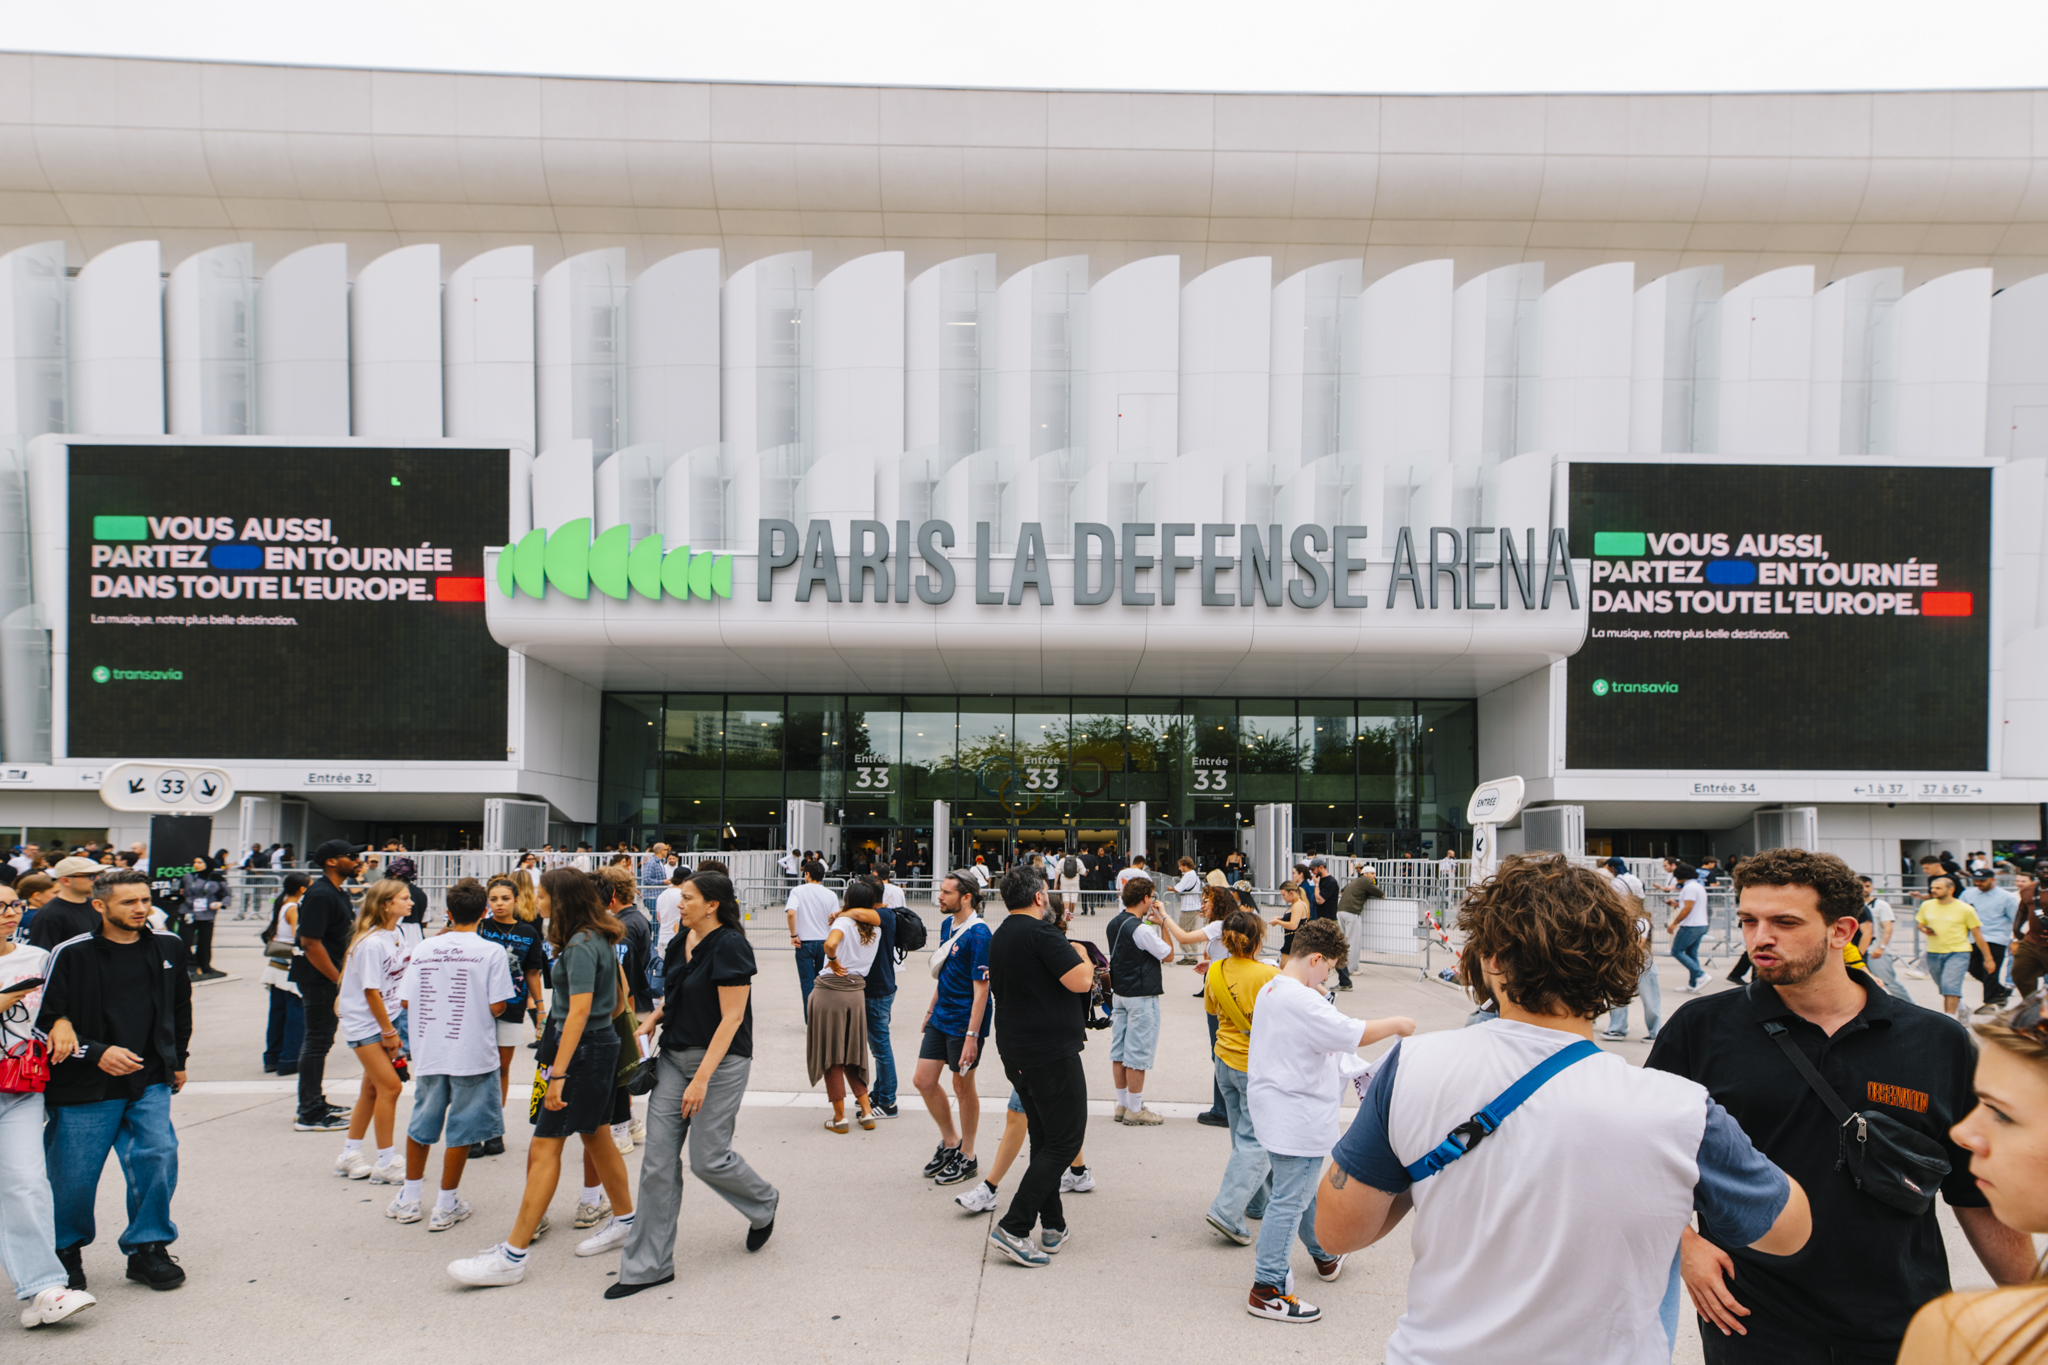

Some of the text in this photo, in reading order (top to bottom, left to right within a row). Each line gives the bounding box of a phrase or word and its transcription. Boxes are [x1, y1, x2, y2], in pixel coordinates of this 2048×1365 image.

[147, 516, 339, 545] VOUS AUSSI,
[1646, 532, 1830, 561] VOUS AUSSI,
[91, 541, 453, 572] PARTEZ EN TOURNÉE
[758, 519, 1580, 610] PARIS LA DEFENSE ARENA
[1592, 557, 1939, 587] PARTEZ EN TOURNÉE
[91, 575, 434, 602] DANS TOUTE L'EUROPE.
[1592, 589, 1920, 616] DANS TOUTE L'EUROPE.
[90, 613, 107, 624] La
[155, 615, 186, 625] notre
[185, 614, 209, 627] plus
[209, 614, 236, 625] belle
[235, 614, 299, 626] destination.
[1592, 627, 1790, 641] La musique, notre plus belle destination.
[112, 667, 184, 681] transavia
[1611, 681, 1679, 694] transavia
[1023, 755, 1061, 765] Entrée
[1191, 756, 1229, 766] Entrée
[308, 772, 373, 784] Entrée 32
[855, 766, 890, 789] 33
[1025, 768, 1060, 790] 33
[1193, 769, 1228, 791] 33
[161, 779, 185, 795] 33
[1694, 782, 1756, 793] Entrée 34
[1868, 783, 1904, 794] 1 à 37
[1923, 783, 1968, 795] 37 à 67
[451, 947, 464, 955] Our
[412, 955, 484, 966] Locations Worldwide!
